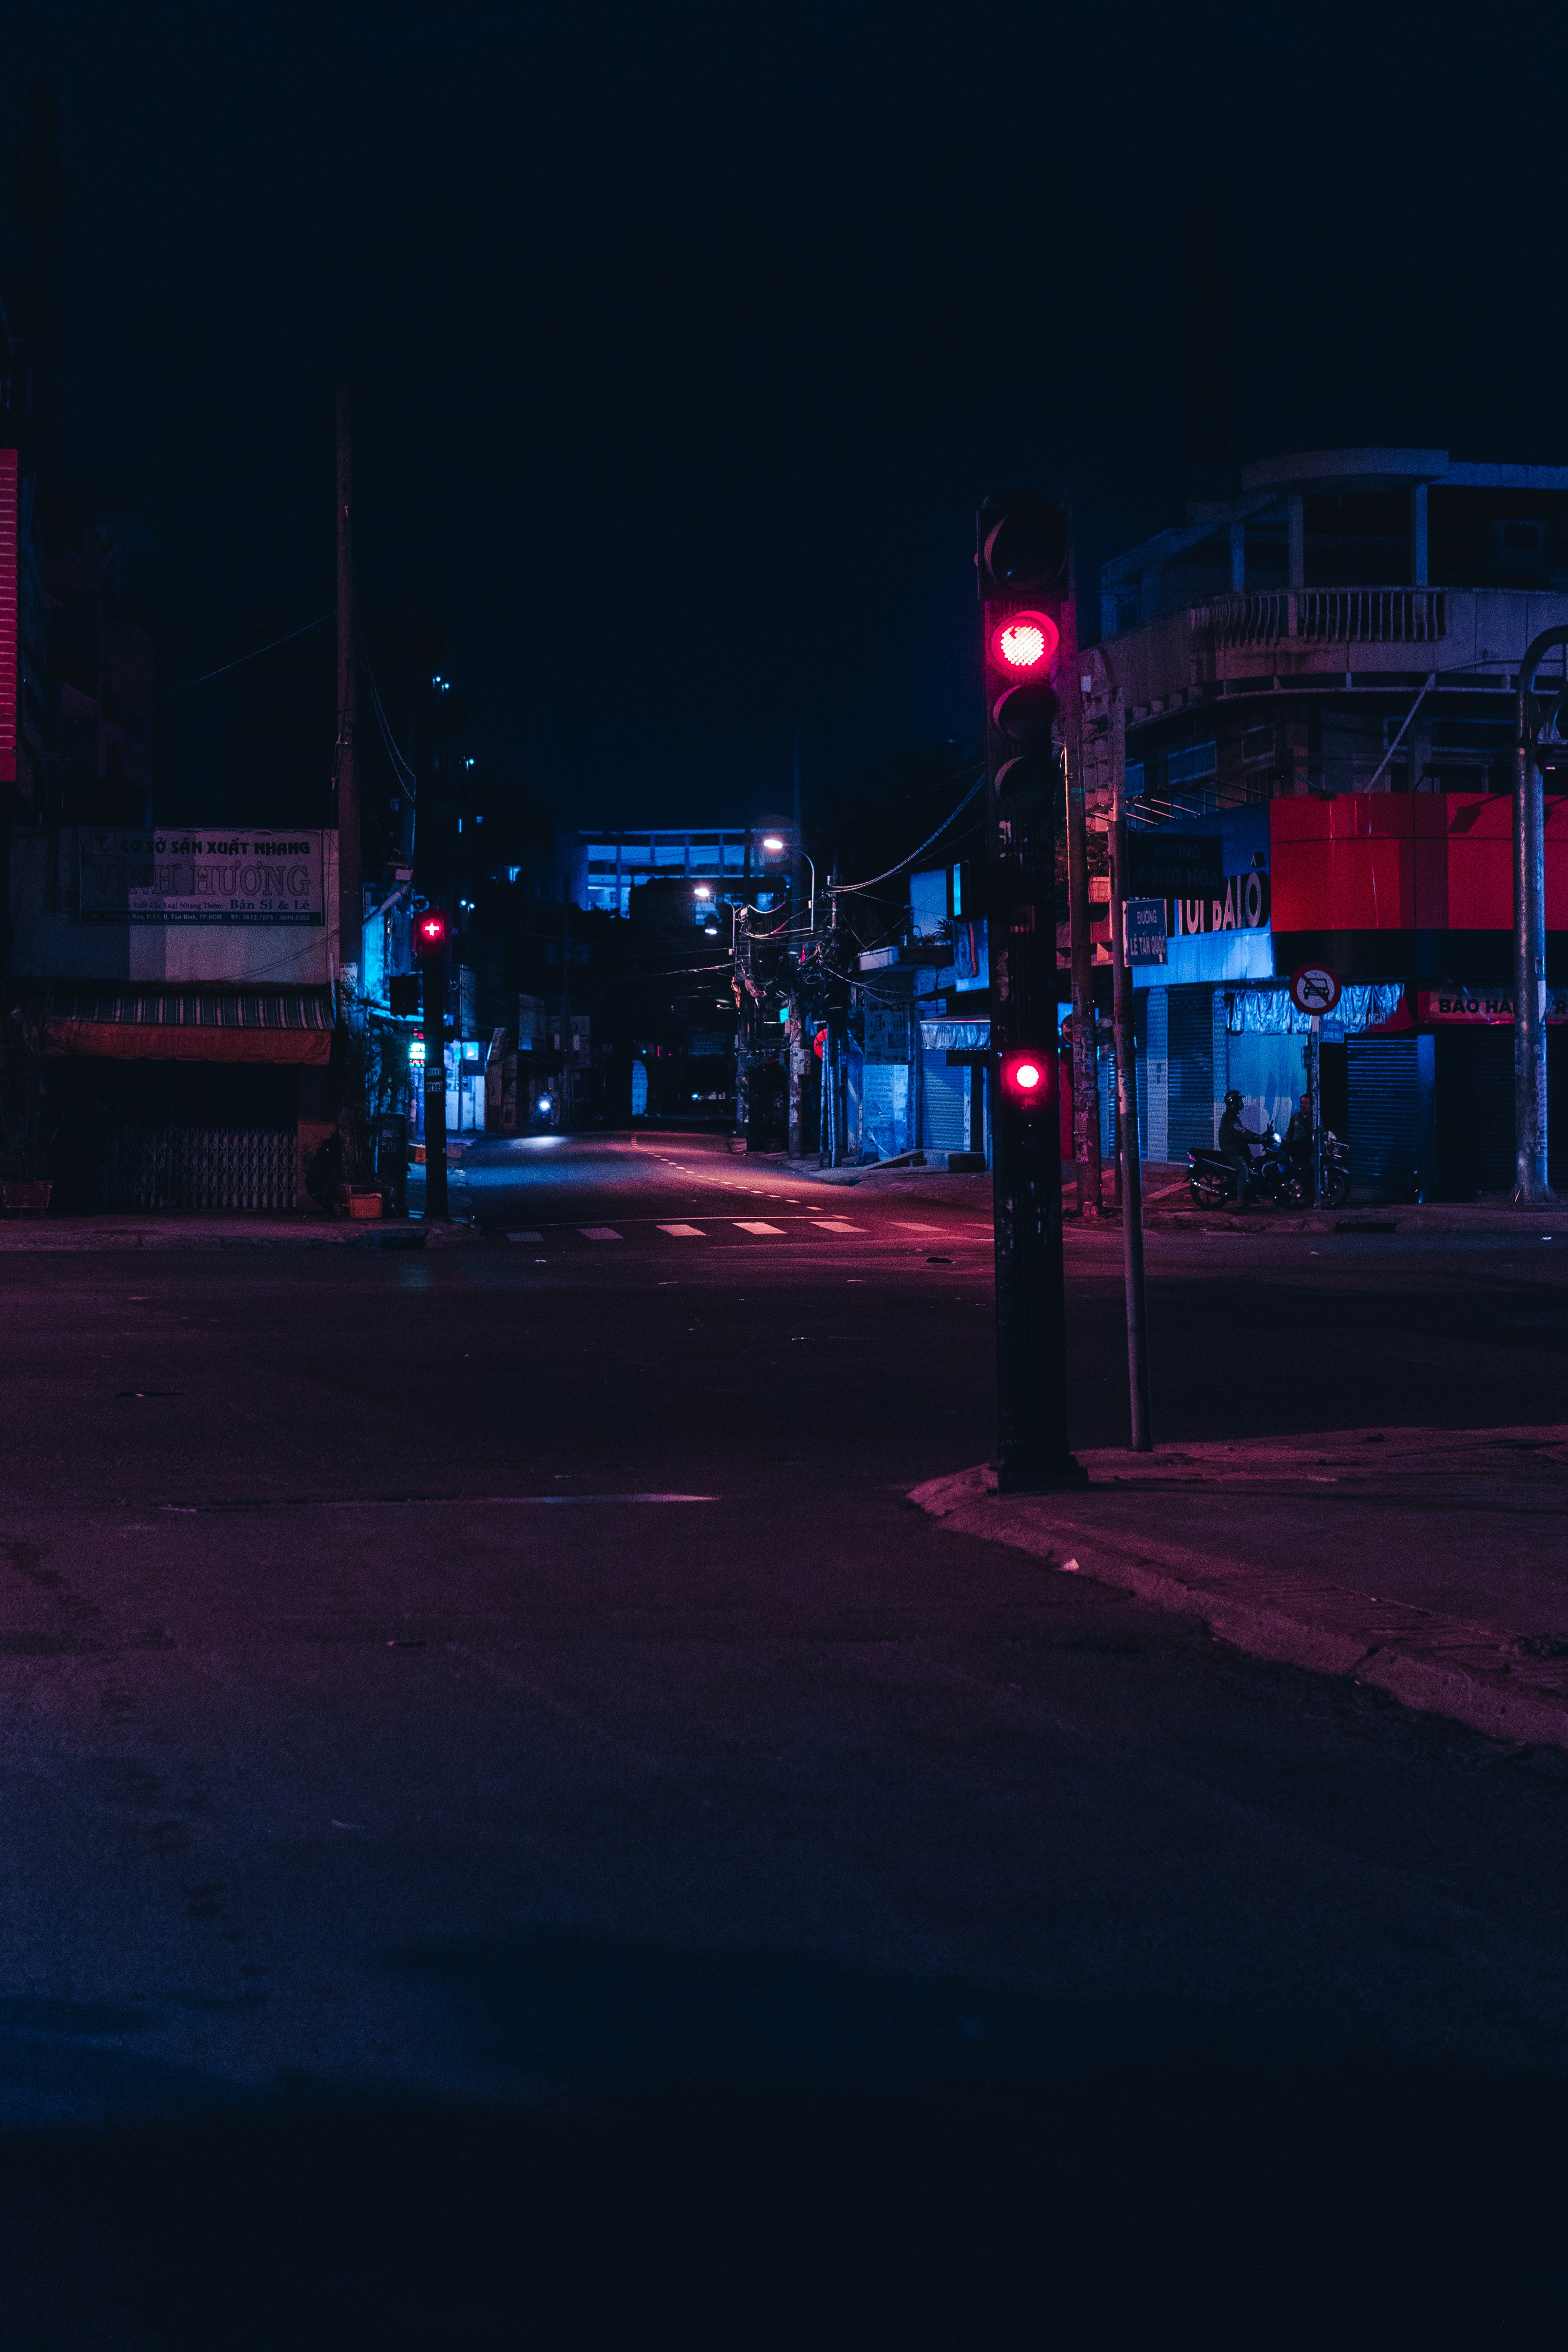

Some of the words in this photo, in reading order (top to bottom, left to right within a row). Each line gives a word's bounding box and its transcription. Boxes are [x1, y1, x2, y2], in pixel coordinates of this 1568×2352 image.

[147, 836, 166, 853] SỞ
[172, 837, 202, 854] SẢN
[207, 838, 249, 856] XUẤT
[255, 842, 310, 856] NHANG
[190, 861, 311, 896] HƯƠNG
[180, 902, 201, 910] Nhang
[231, 900, 255, 909] Bán
[278, 901, 289, 909] &
